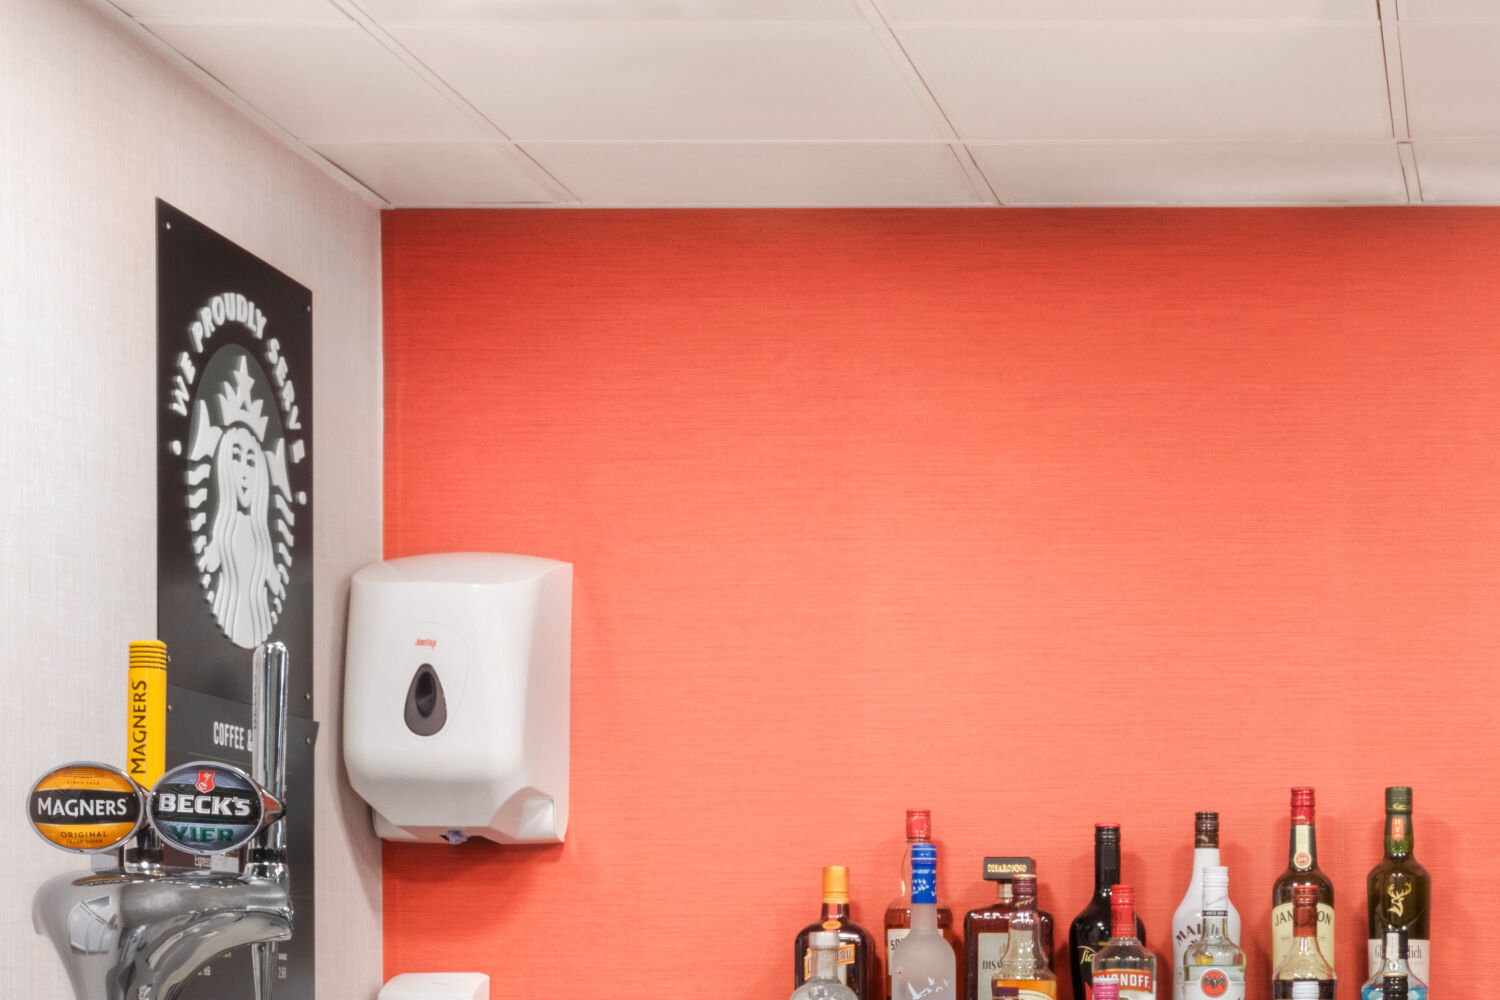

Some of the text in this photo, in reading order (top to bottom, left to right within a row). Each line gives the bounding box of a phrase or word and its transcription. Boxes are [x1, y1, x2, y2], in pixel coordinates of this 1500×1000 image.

[171, 292, 306, 464] WE PROUDLY SERVE
[131, 679, 147, 774] MAGNERS
[213, 720, 245, 751] COFFEE
[37, 796, 128, 818] MAGNERS
[158, 793, 251, 817] BECK'S
[60, 831, 107, 839] ORIGINAL
[169, 825, 235, 843] VIER
[987, 863, 1027, 873] DISARONNO
